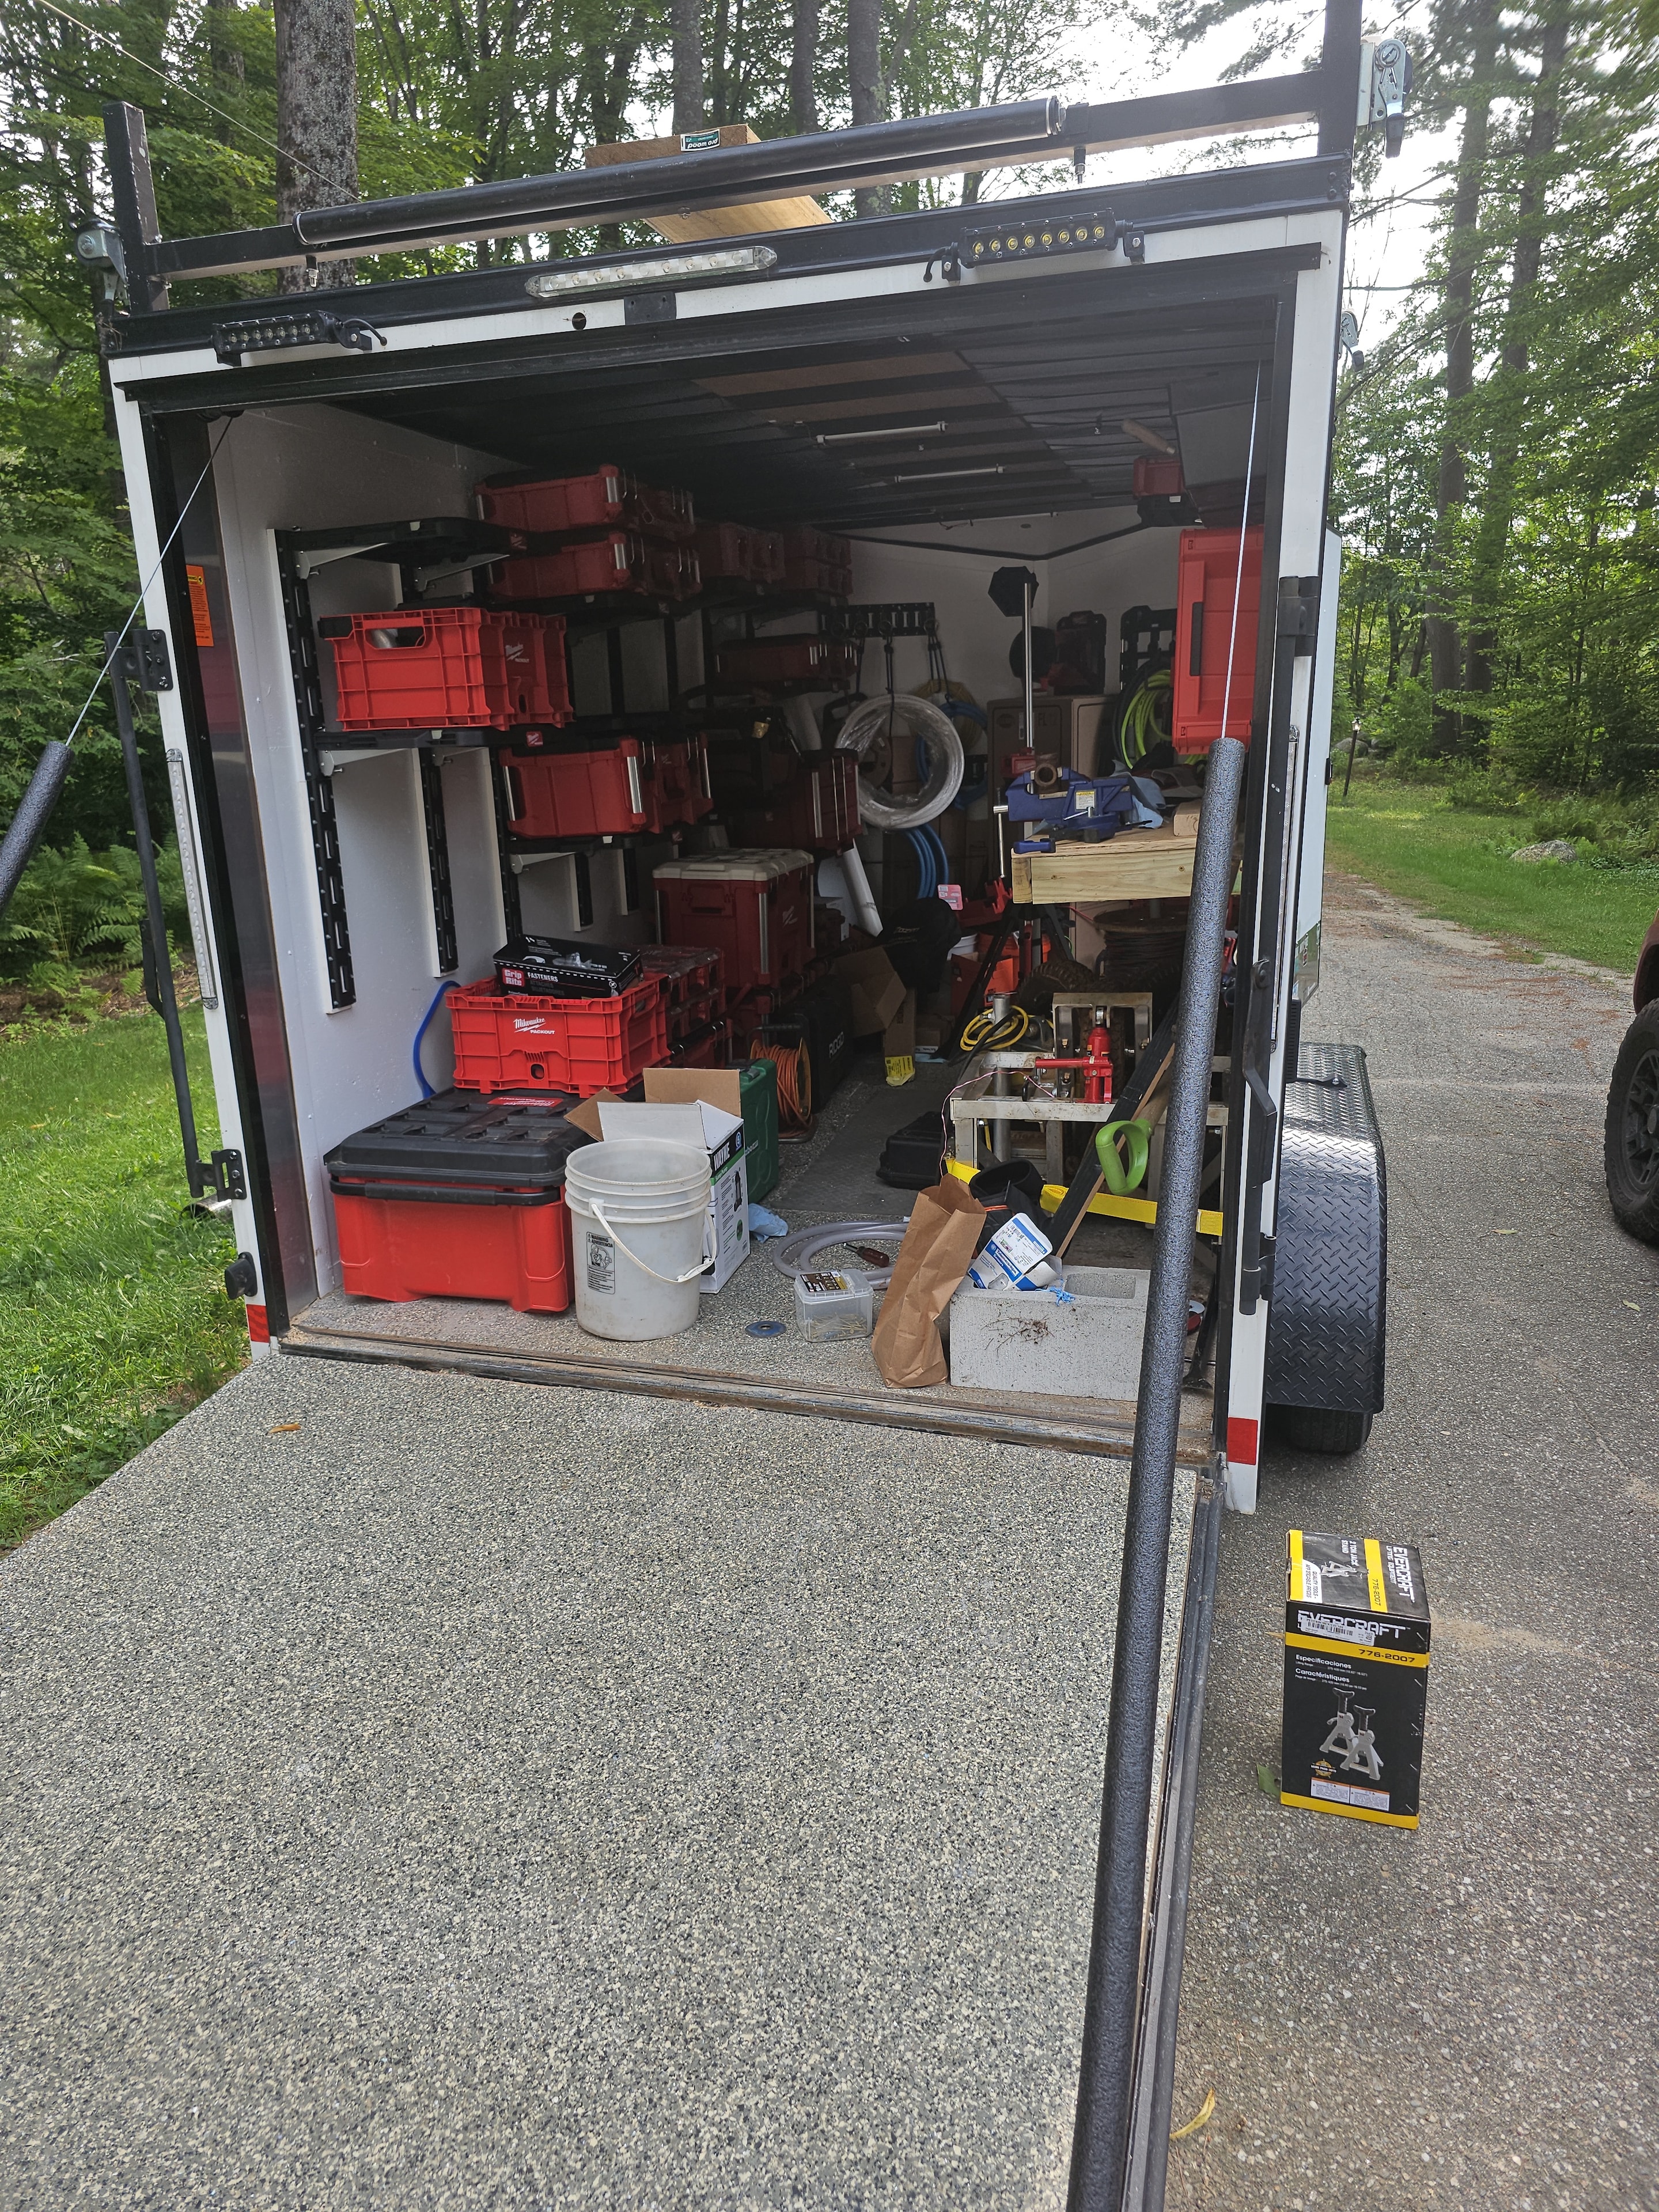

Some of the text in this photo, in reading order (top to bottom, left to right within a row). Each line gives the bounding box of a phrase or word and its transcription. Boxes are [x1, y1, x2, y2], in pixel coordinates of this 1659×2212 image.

[687, 141, 707, 149] wood
[707, 137, 718, 145] pro
[504, 970, 522, 980] Grip
[528, 972, 559, 982] FASTENERS
[505, 977, 522, 986] Rite
[513, 1017, 546, 1029] Milwaukee
[713, 1141, 730, 1171] WAYNE
[591, 1234, 609, 1243] WARNING
[591, 1239, 613, 1248] ADVERTENCIA
[1341, 1540, 1349, 1554] STAND
[1350, 1554, 1359, 1566] JACK
[1386, 1546, 1397, 1584] LIFTING EQUIPMENT
[1393, 1546, 1414, 1601] EVERCRAFT
[1372, 1578, 1381, 1606] 776-2007
[1296, 1654, 1352, 1669] Especificaciones
[1358, 1649, 1415, 1662] 776-2007
[1295, 1668, 1350, 1683] Caractéristiques
